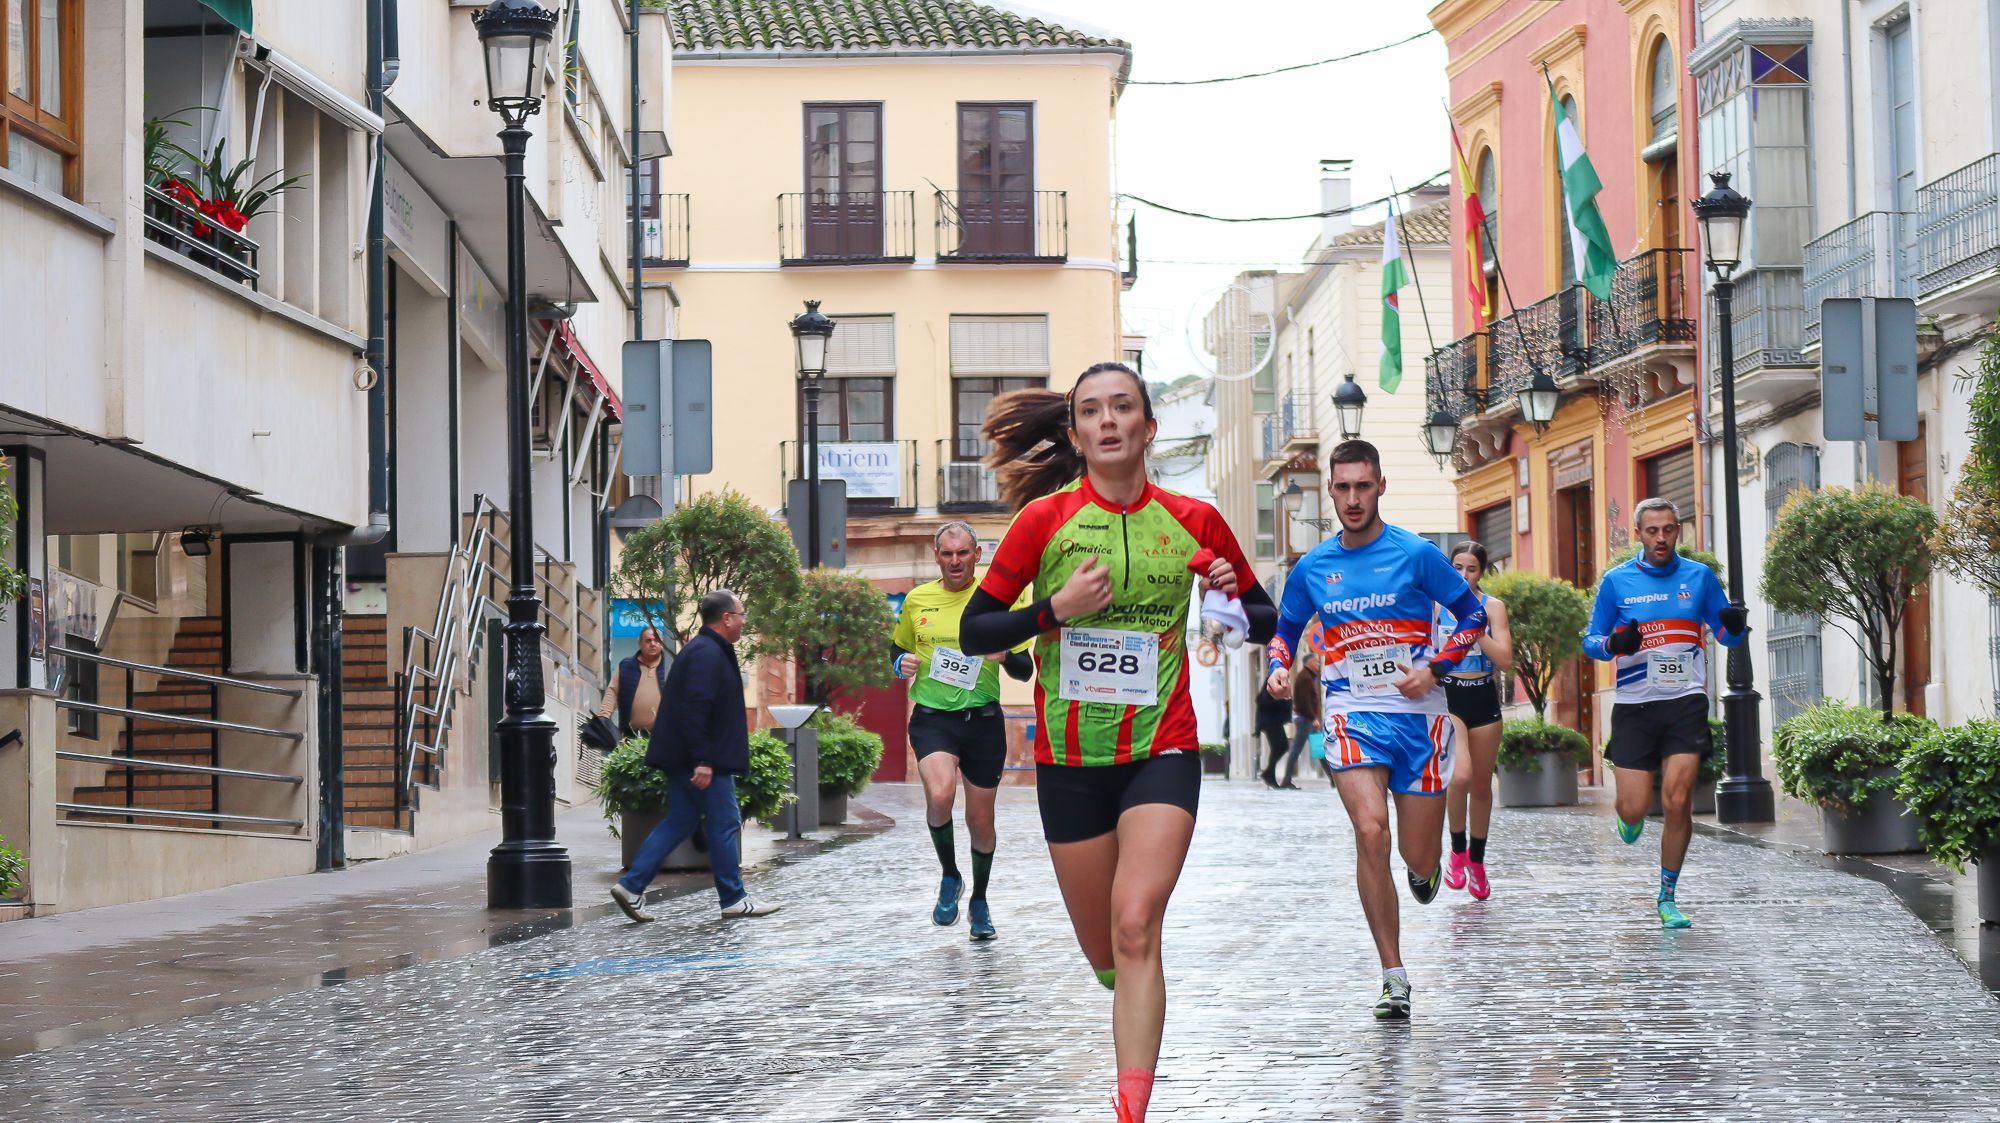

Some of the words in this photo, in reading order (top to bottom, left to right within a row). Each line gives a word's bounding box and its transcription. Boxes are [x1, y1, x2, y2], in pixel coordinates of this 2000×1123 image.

[1157, 575, 1183, 585] DUE
[1323, 592, 1397, 614] enerplus
[1624, 592, 1669, 605] enerplus
[1138, 615, 1171, 628] Motor
[1340, 621, 1394, 640] Maratón
[1069, 640, 1090, 648] Ciudad
[1098, 643, 1120, 651] Lucena
[940, 658, 970, 675] 392
[1077, 651, 1139, 675] 628
[1362, 660, 1396, 678] 118
[1658, 663, 1684, 674] 391
[1456, 679, 1485, 687] NIKE
